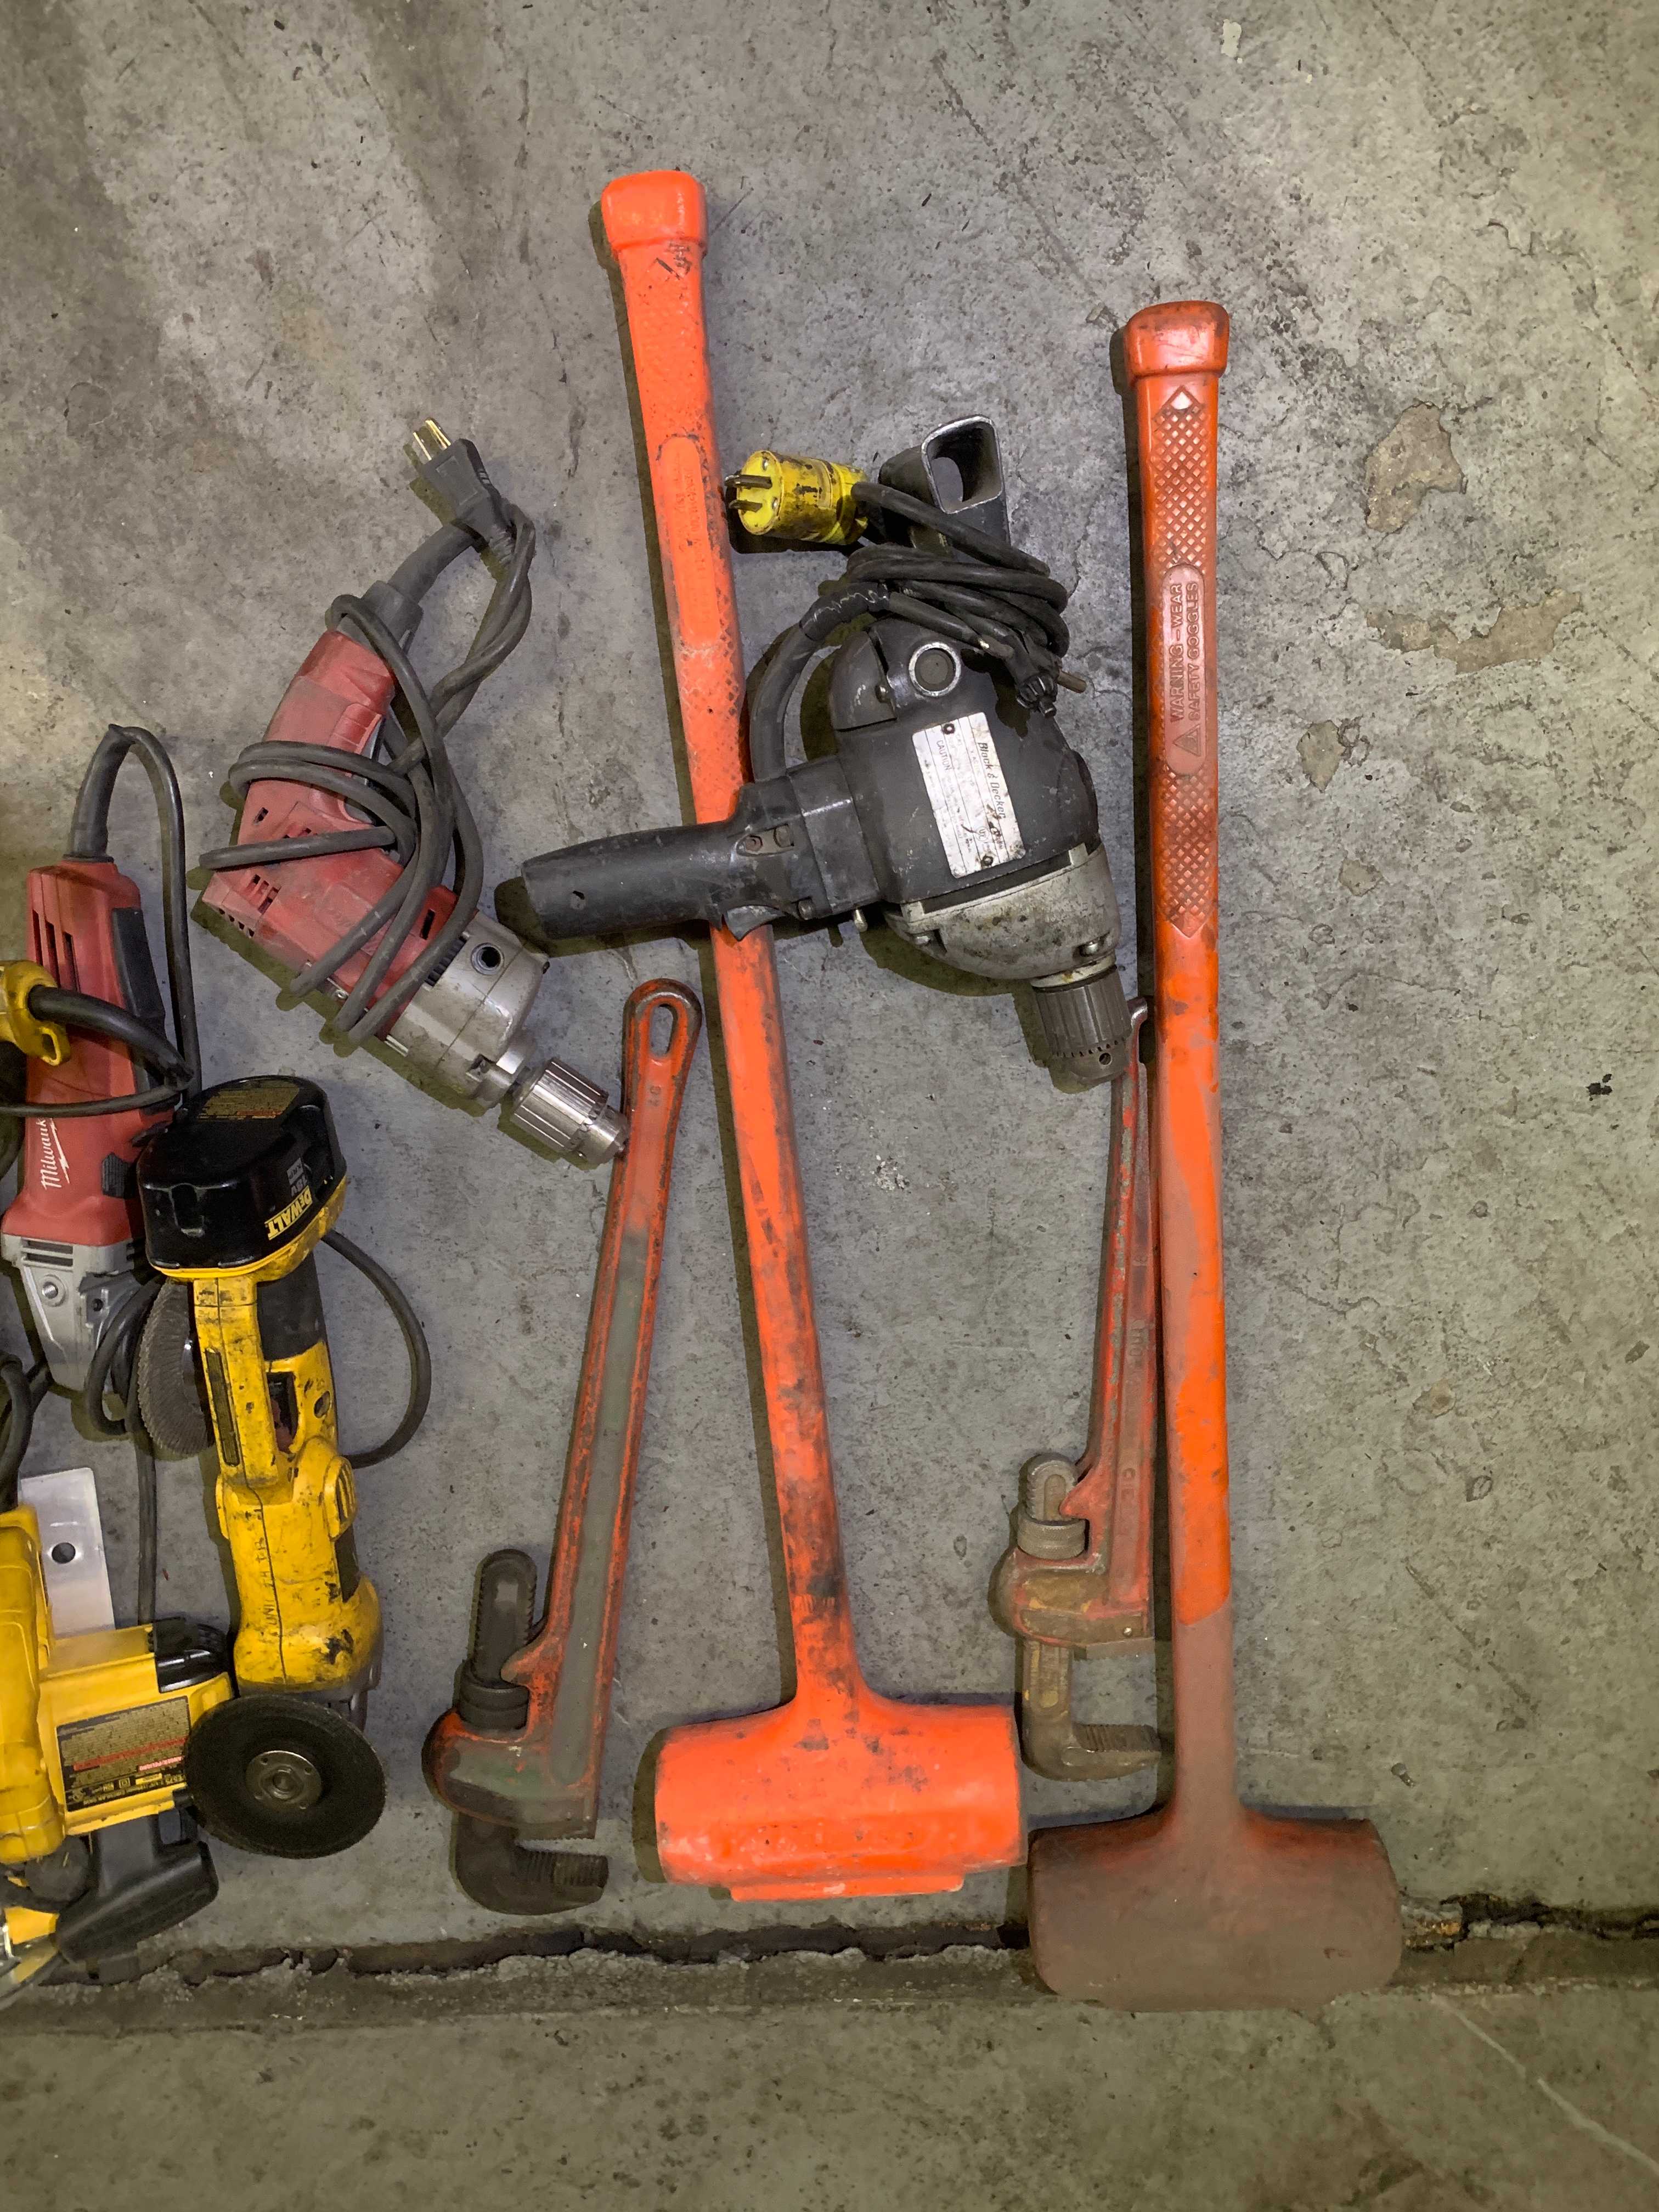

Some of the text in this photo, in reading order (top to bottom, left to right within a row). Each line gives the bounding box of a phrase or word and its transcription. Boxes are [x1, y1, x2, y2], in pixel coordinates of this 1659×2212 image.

[1170, 583, 1182, 627] WEAR
[1169, 644, 1184, 723] WARNING
[1186, 582, 1200, 721] SAFETY GOGGLES
[936, 740, 953, 771] CAUTION
[977, 742, 993, 770] Black
[989, 782, 1007, 819] Decker
[35, 1118, 61, 1190] Milwauk
[266, 1192, 312, 1237] DEWALT
